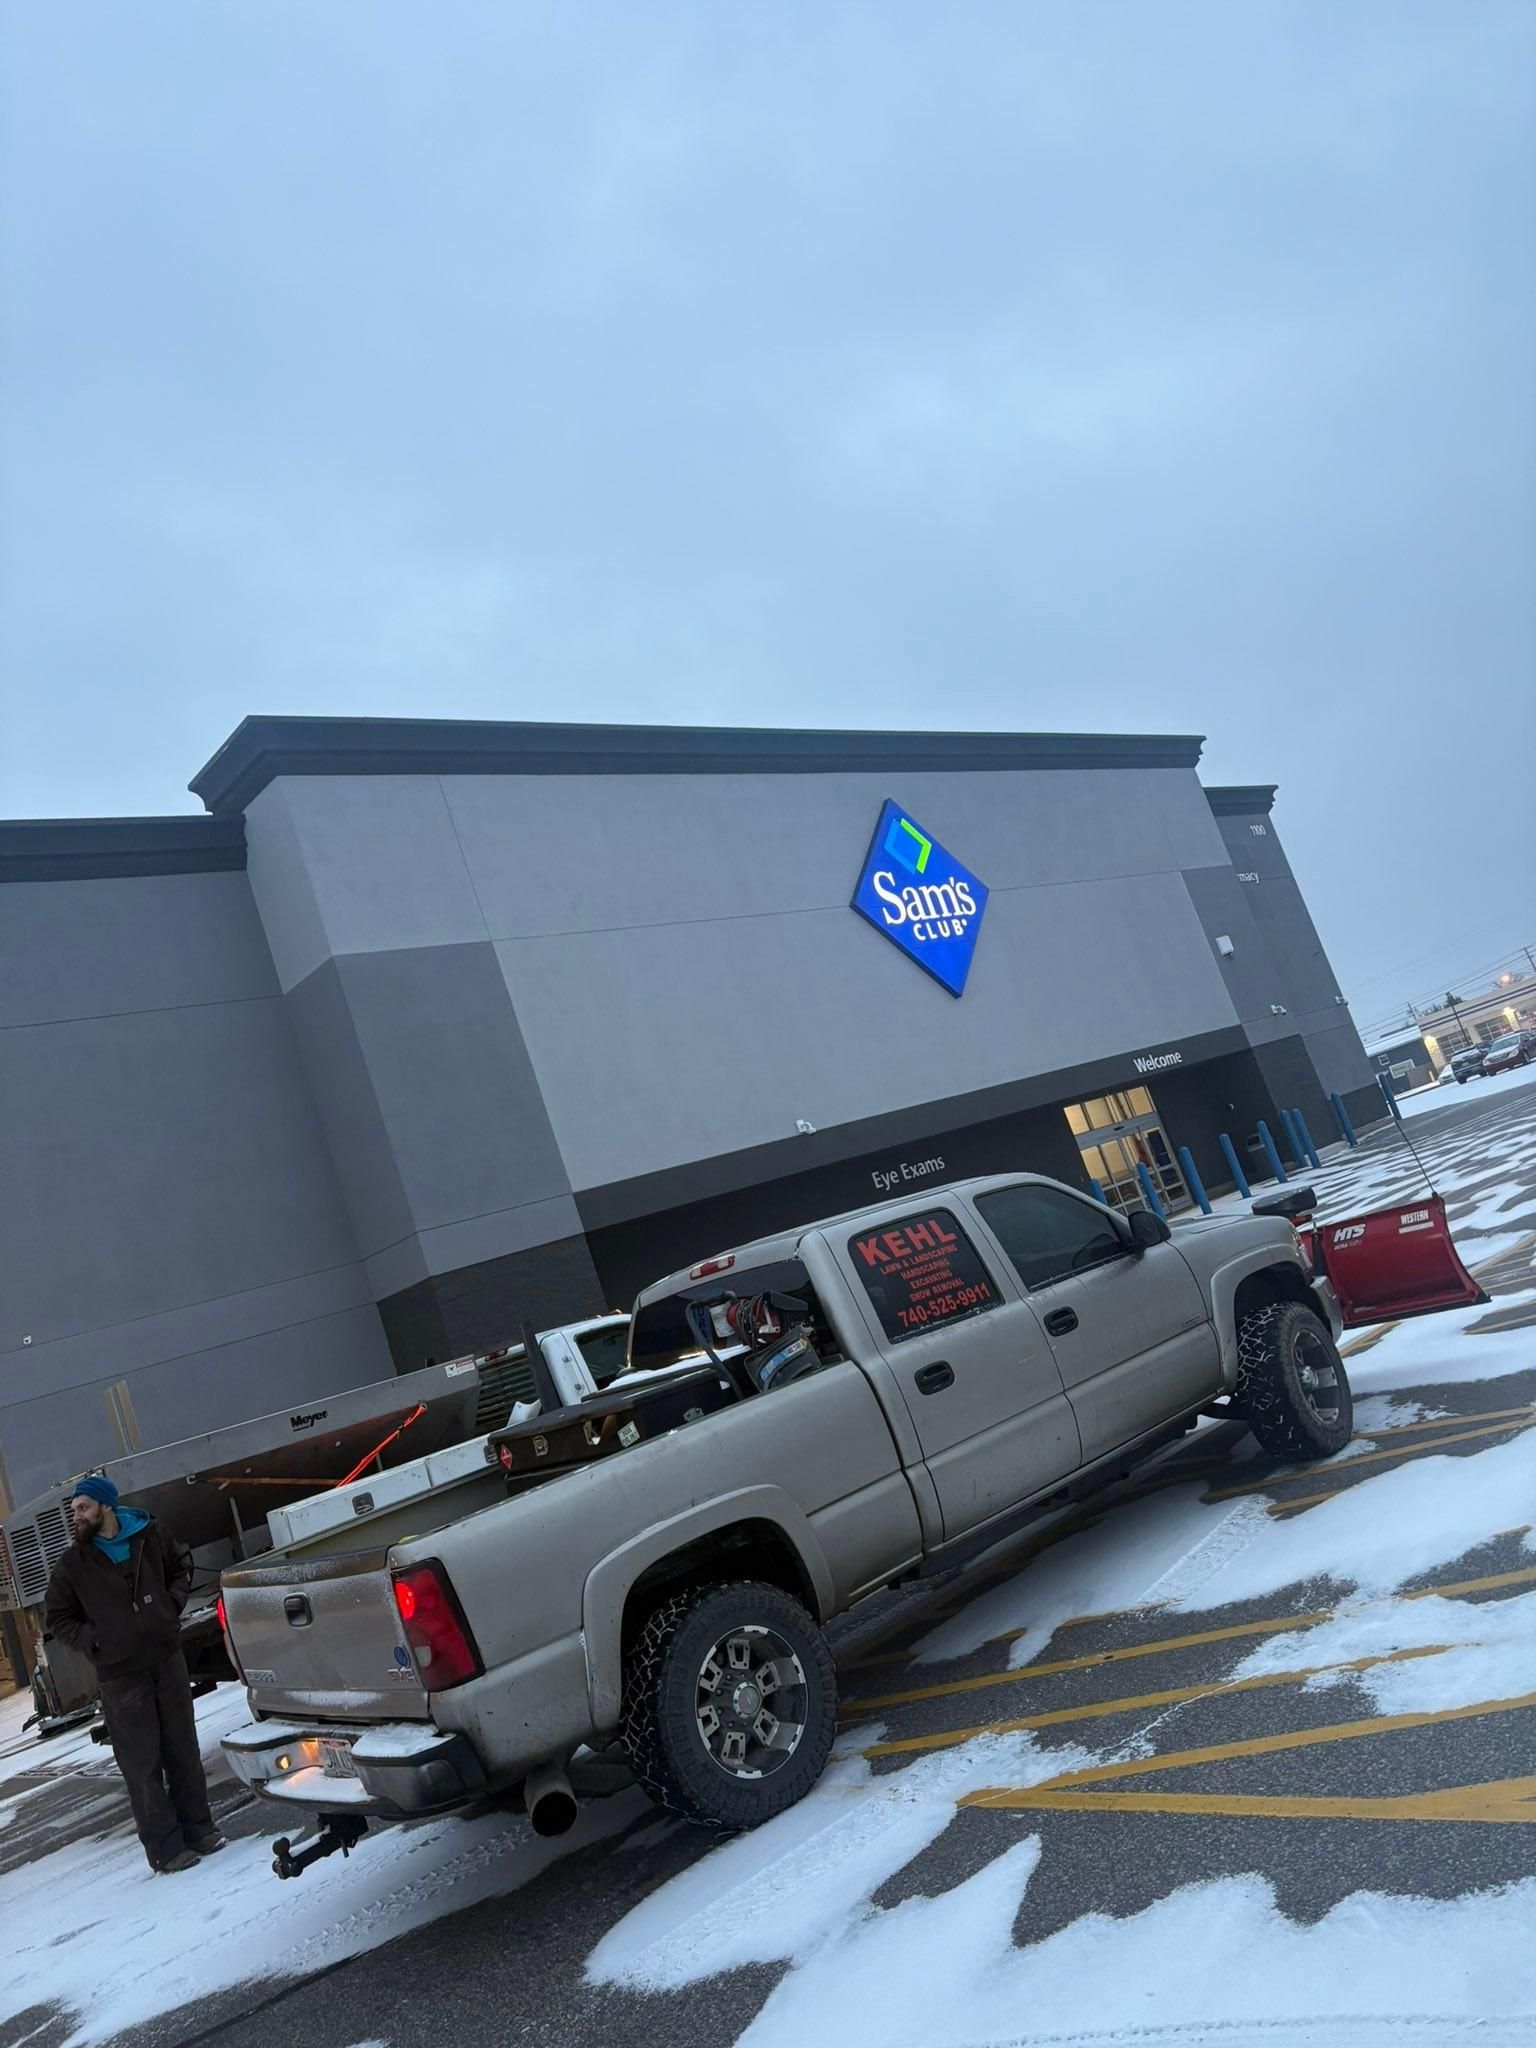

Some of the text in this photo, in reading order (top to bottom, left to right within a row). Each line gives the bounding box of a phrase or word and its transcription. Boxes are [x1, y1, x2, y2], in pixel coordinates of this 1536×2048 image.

[873, 871, 976, 925] Sam's
[913, 919, 964, 941] CLUB
[1133, 1052, 1183, 1073] Welcome
[871, 1156, 945, 1191] Eye Exams
[1400, 1209, 1429, 1225] WESTERN
[856, 1220, 957, 1266] KEHL
[1333, 1223, 1366, 1243] HTS
[880, 1262, 902, 1275] LAWN
[909, 1244, 958, 1265] LANDSCAPING
[901, 1258, 951, 1280] HARDSCAPING
[910, 1269, 953, 1289] EXCAVATING
[910, 1278, 964, 1302] SNOW REMOVAL
[897, 1282, 991, 1328] 740-525-9911
[290, 1410, 328, 1428] Meyer
